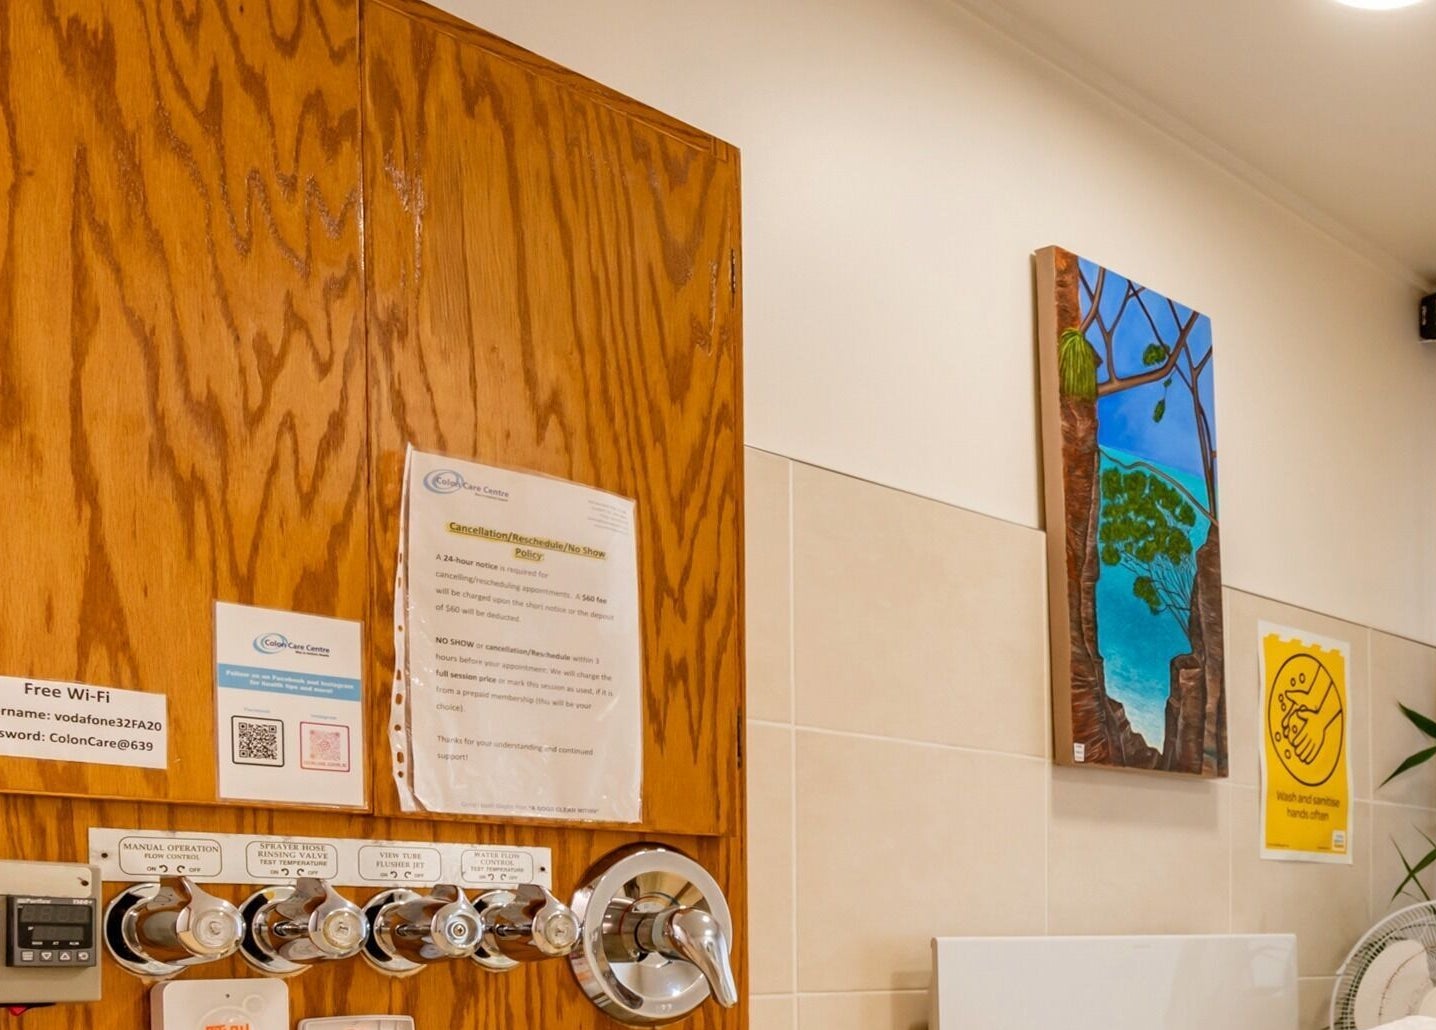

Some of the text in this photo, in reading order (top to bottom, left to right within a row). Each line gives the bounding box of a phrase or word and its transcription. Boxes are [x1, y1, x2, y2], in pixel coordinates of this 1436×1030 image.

[436, 477, 461, 488] Colon
[462, 482, 481, 492] Care
[483, 486, 509, 497] Centre
[515, 548, 543, 561] Policy
[583, 546, 606, 558] Show
[444, 554, 474, 566] 24-hour
[476, 561, 498, 570] notice
[538, 570, 548, 578] for
[436, 588, 449, 596] will
[451, 590, 461, 598] be
[462, 592, 491, 602] charged
[545, 604, 566, 613] notice
[578, 609, 588, 617] the
[596, 596, 607, 604] fee
[264, 639, 287, 649] Colon
[288, 642, 304, 651] Care
[306, 644, 330, 654] Centre
[436, 636, 449, 645] NO
[450, 638, 475, 648] SHOW
[572, 656, 594, 664] within
[436, 654, 458, 662] hours
[460, 656, 482, 665] before
[450, 672, 478, 681] session
[479, 676, 497, 684] price
[24, 682, 110, 703] Free Wi-Fi
[54, 712, 162, 732] vodafone32FA20
[50, 732, 154, 751] ColonCare@639
[438, 736, 463, 745] Thanks
[464, 738, 475, 746] for
[476, 740, 492, 749] your
[1276, 790, 1297, 802] Wash
[1298, 794, 1312, 804] and
[1287, 808, 1329, 821] hands often
[124, 843, 219, 853] MANUAL OPERATION
[260, 843, 326, 852] SPRAYER HOSE
[376, 860, 410, 868] FLUSHER
